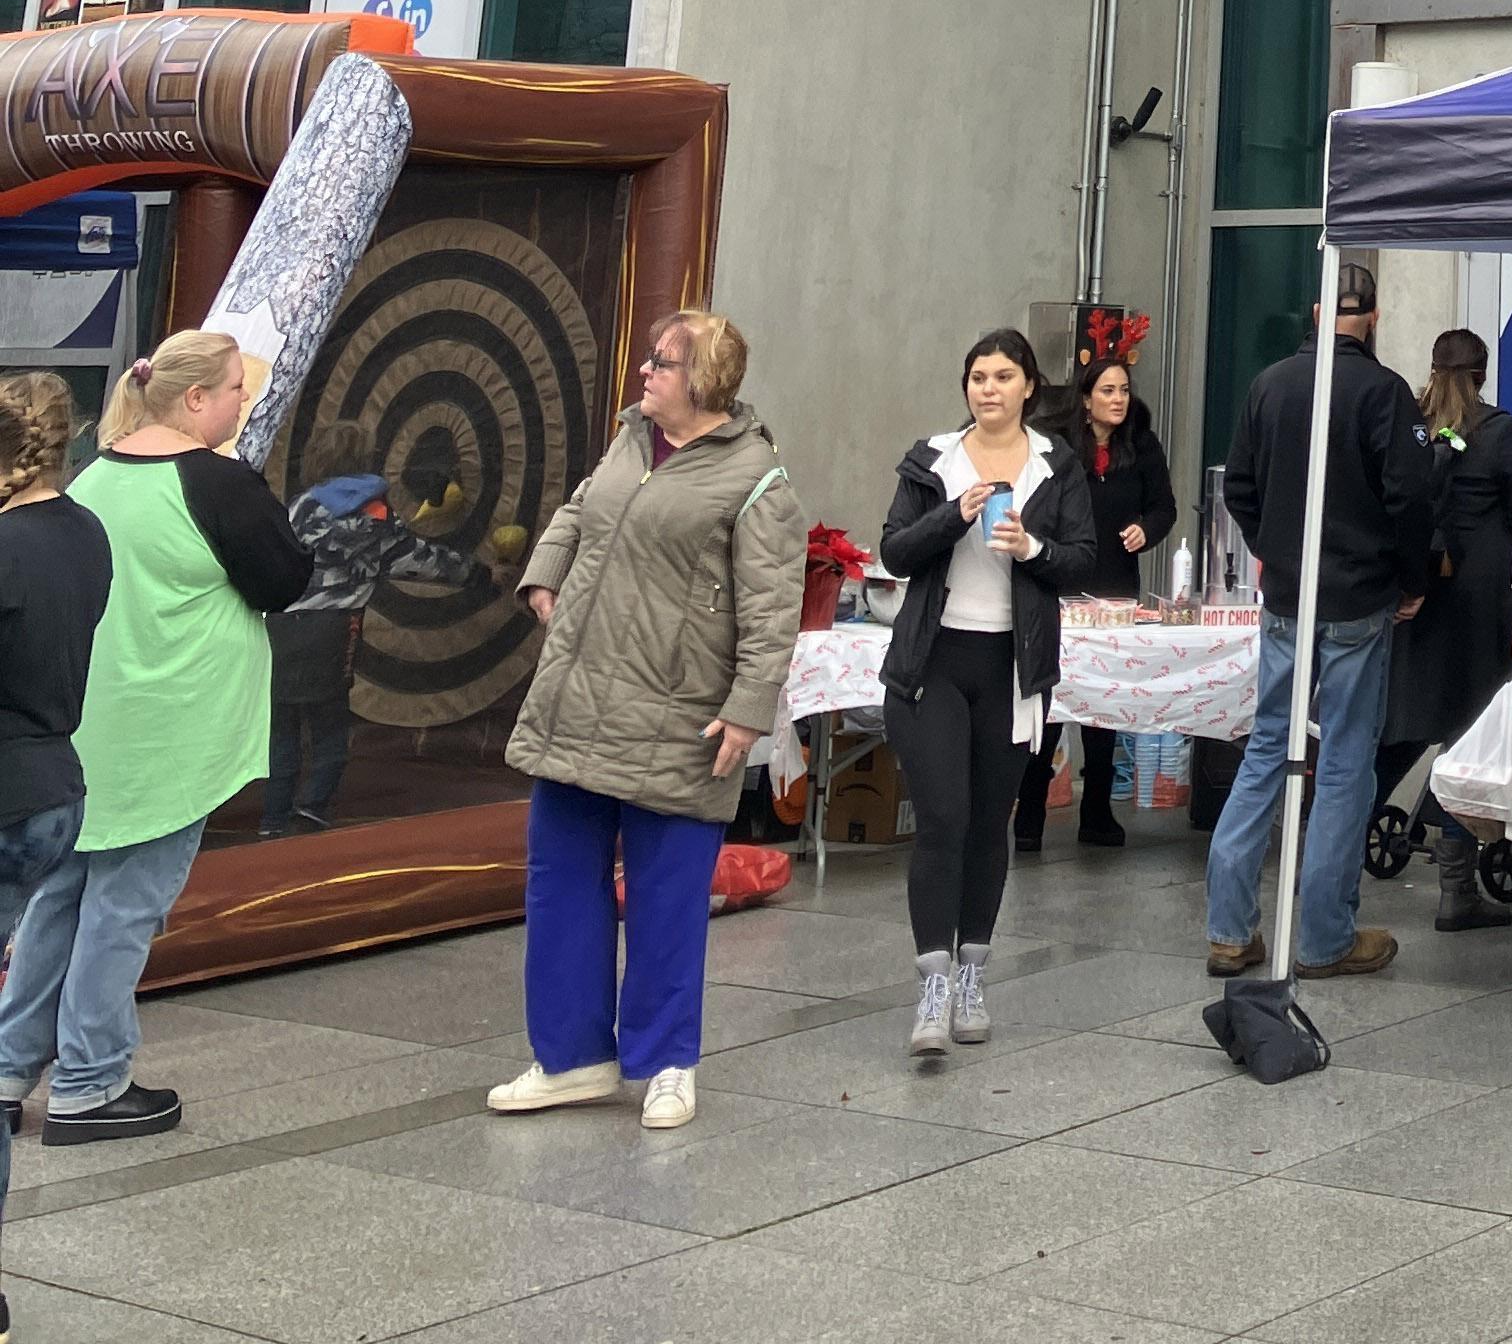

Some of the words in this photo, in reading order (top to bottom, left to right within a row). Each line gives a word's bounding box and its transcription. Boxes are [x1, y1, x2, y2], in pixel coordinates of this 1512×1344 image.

[24, 21, 221, 123] AXE
[44, 130, 196, 154] THROWING
[1204, 609, 1225, 626] HOT
